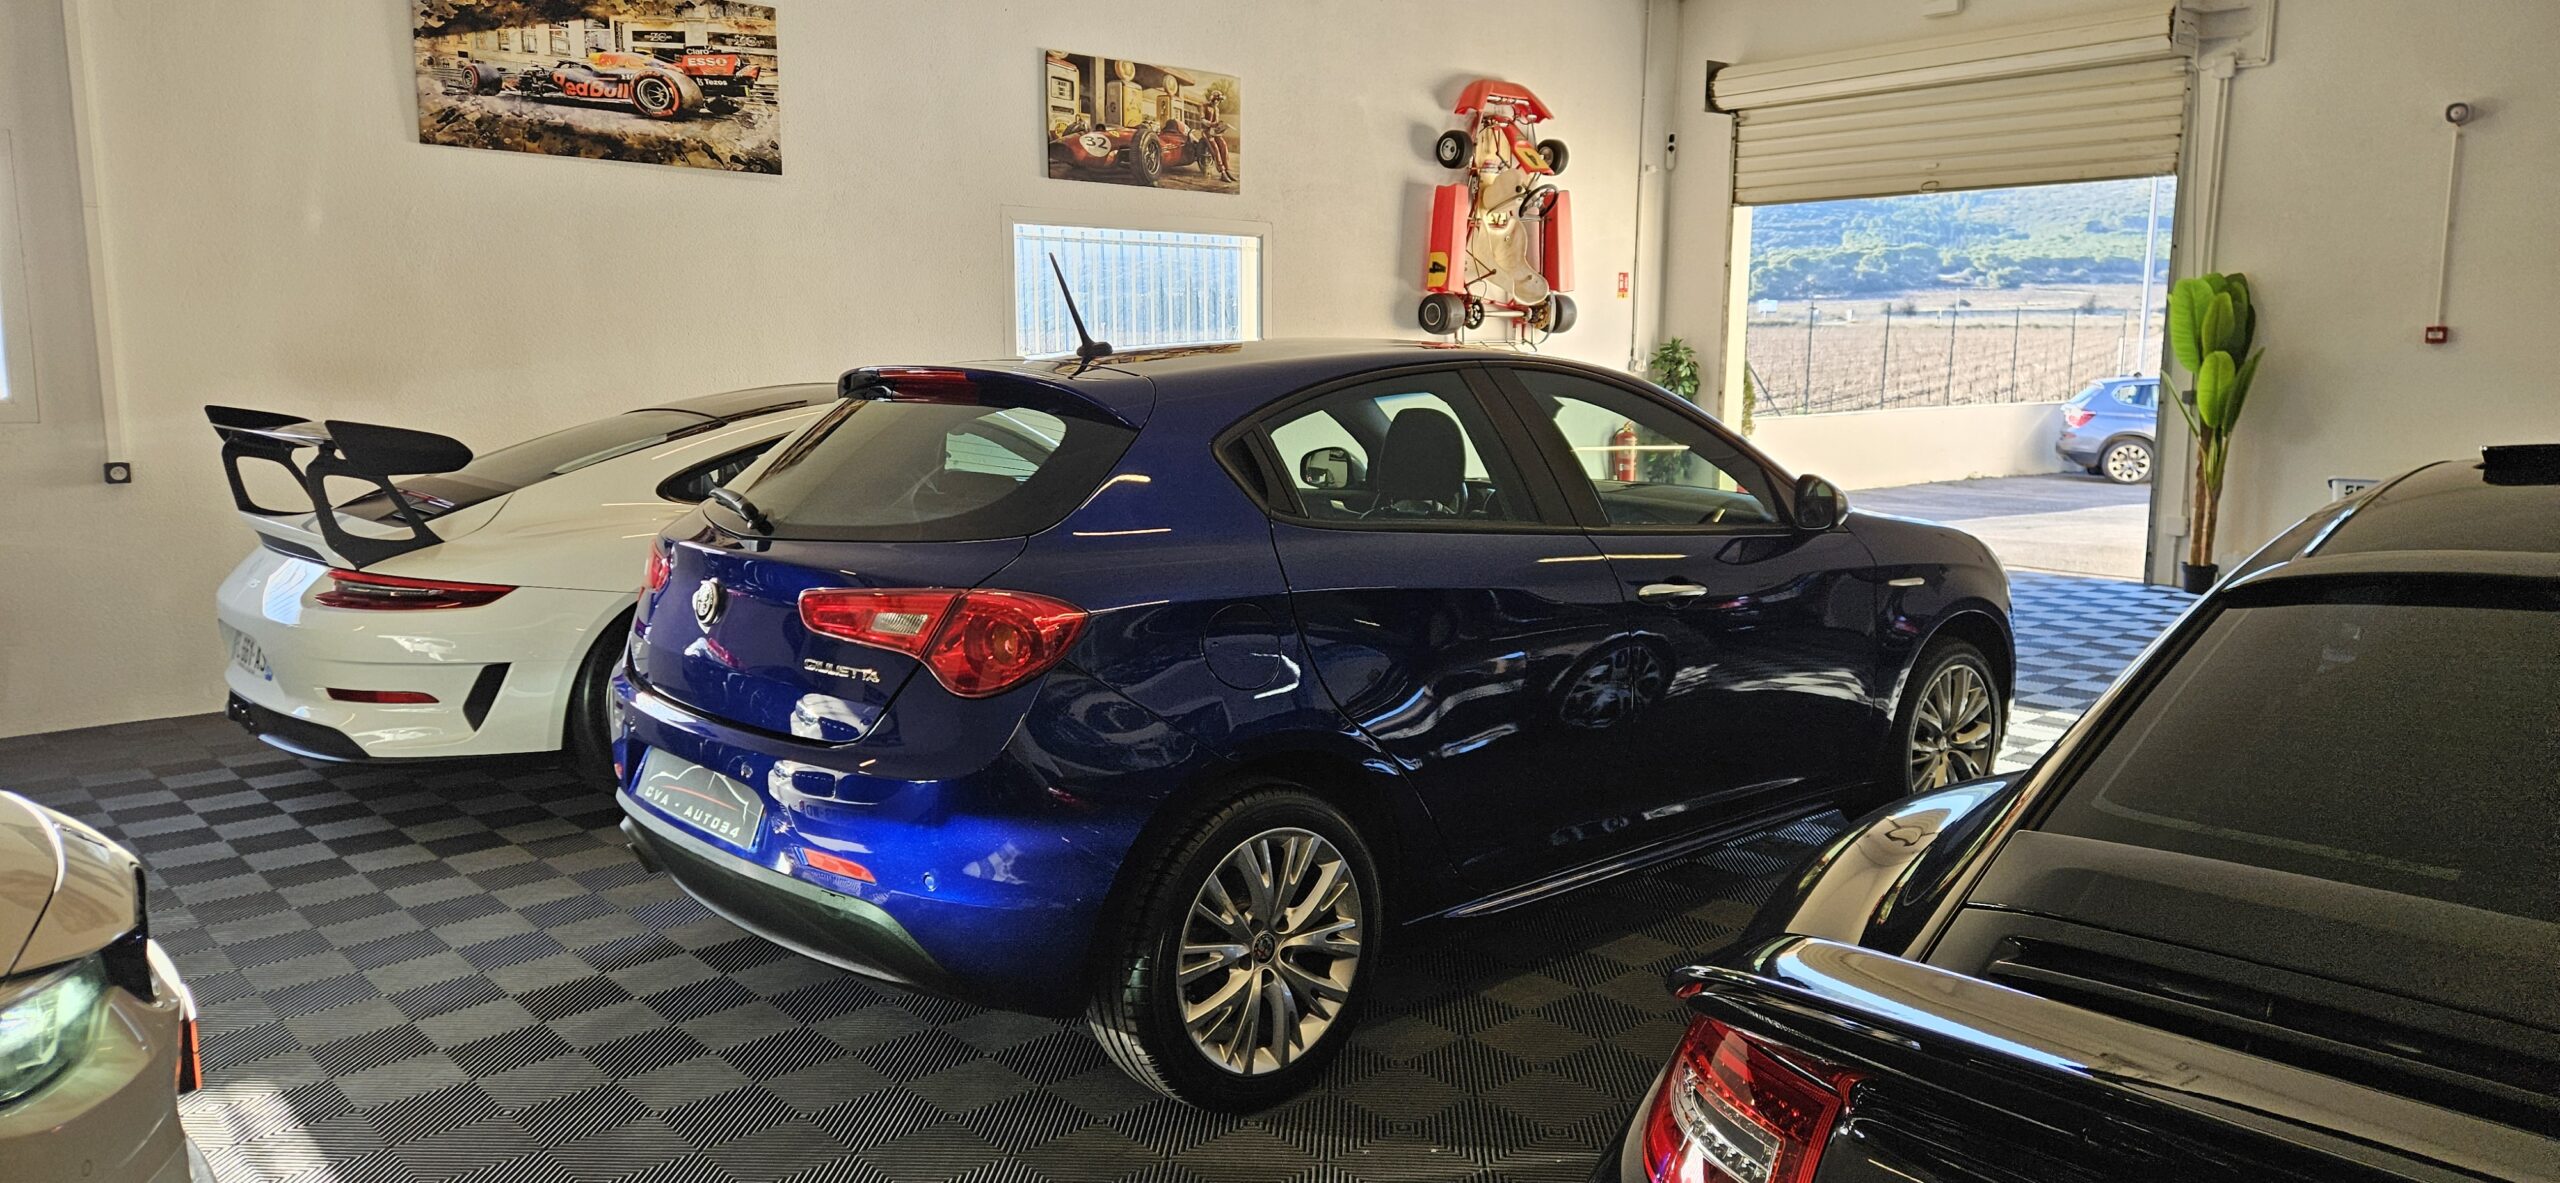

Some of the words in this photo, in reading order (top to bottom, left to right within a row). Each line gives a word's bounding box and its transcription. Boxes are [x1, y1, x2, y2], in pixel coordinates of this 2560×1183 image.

[686, 47, 710, 55] Claro
[704, 78, 728, 86] Tezos
[1084, 136, 1108, 149] 32
[1429, 261, 1446, 274] 4
